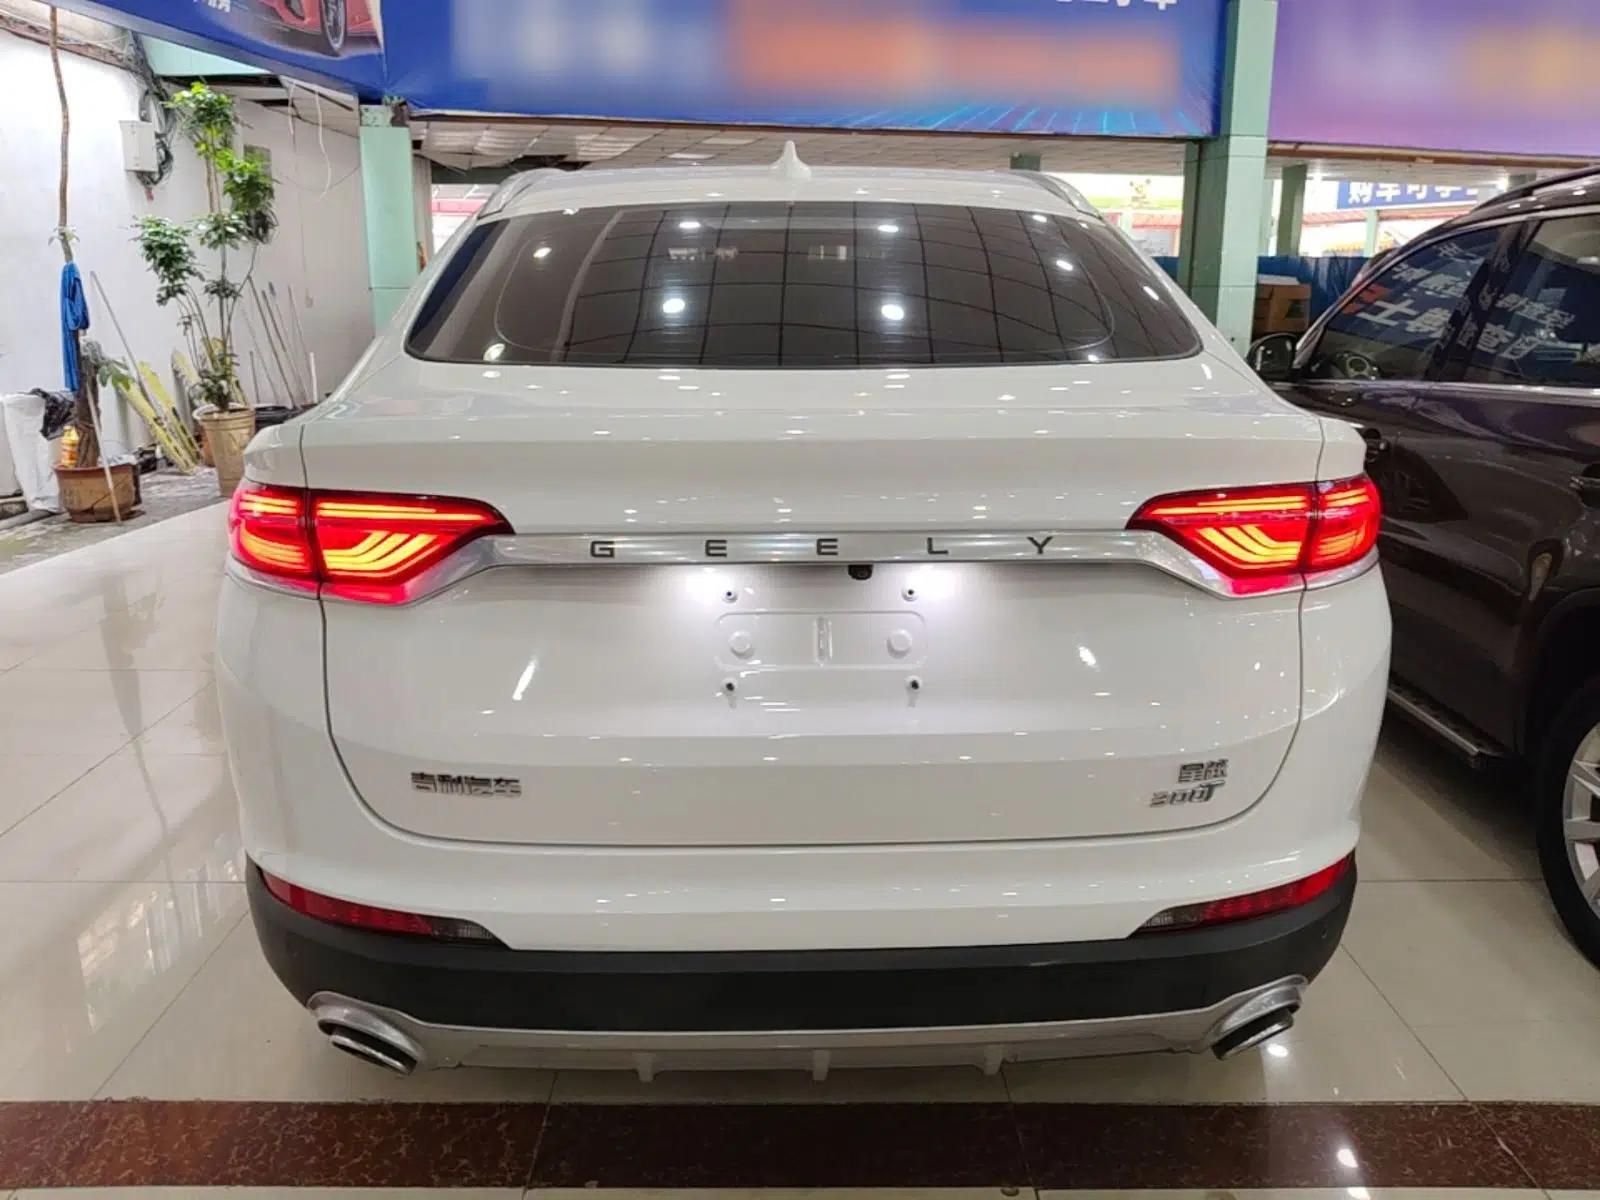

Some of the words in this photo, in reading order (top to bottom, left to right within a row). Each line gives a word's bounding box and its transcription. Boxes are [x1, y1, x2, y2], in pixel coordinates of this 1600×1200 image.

[591, 537, 1053, 558] GEELY
[411, 771, 521, 797] 吉利汽车
